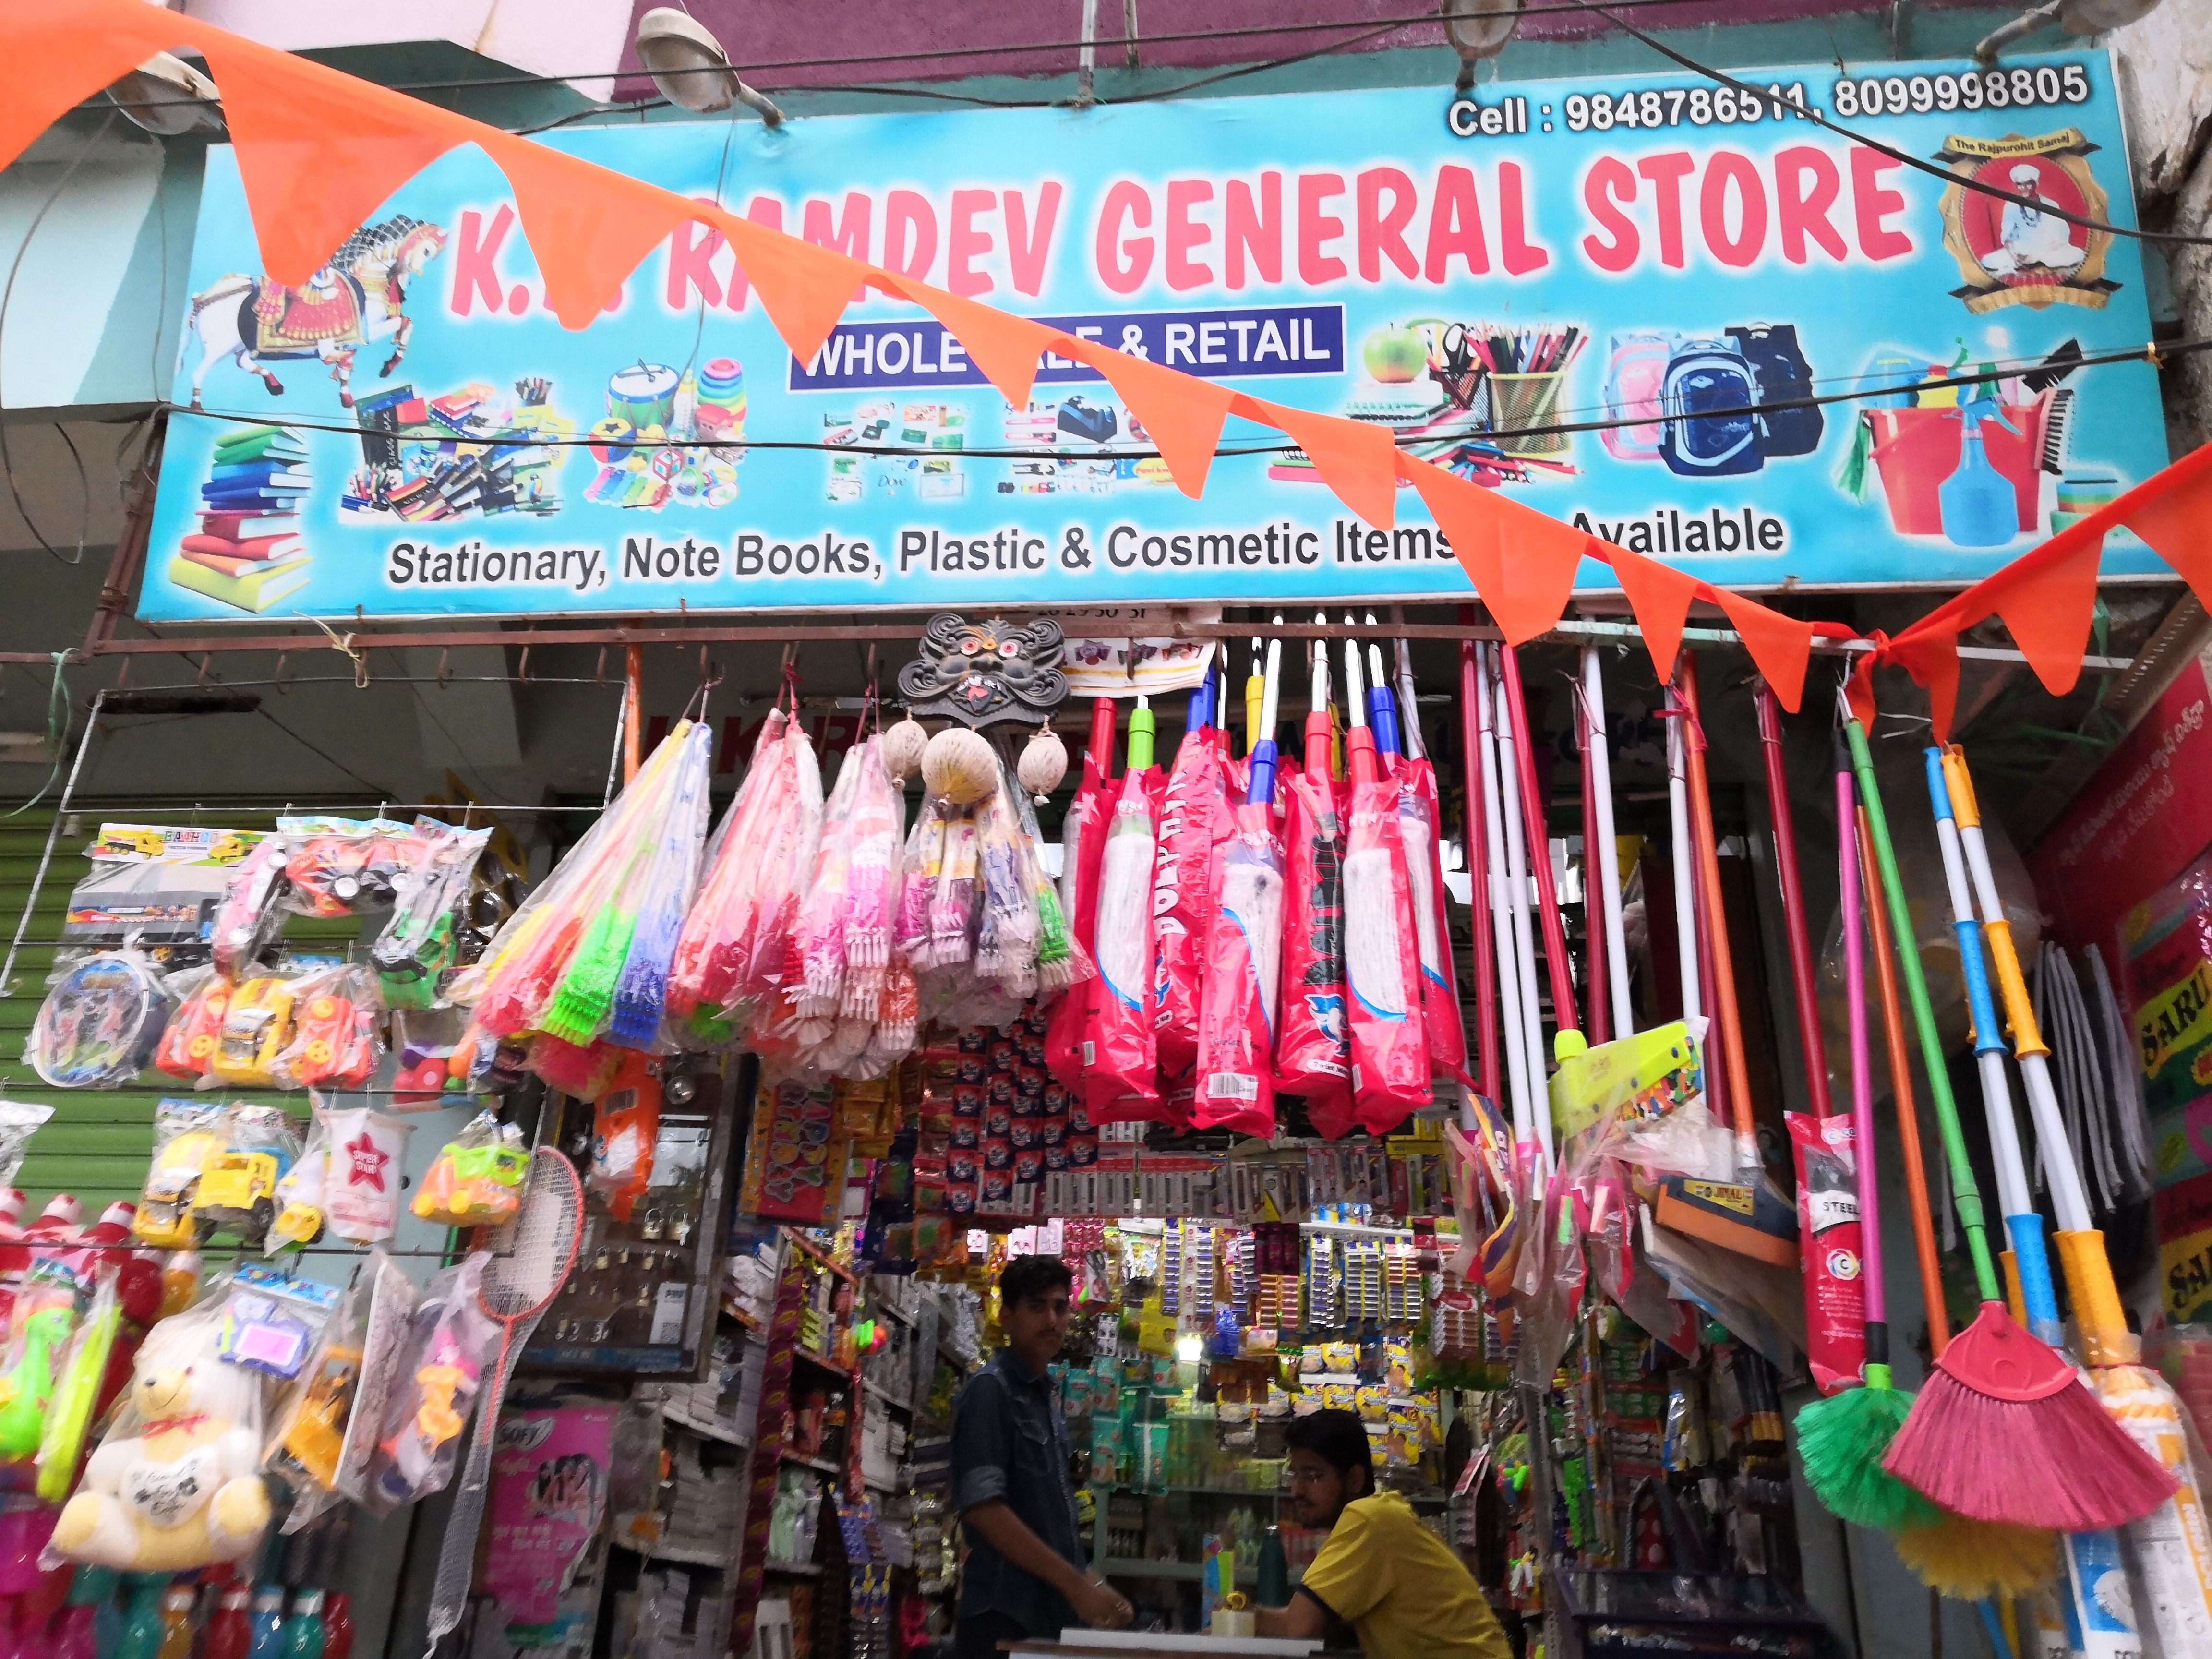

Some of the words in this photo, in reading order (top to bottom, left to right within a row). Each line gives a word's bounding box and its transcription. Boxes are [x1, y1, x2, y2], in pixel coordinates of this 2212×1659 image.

[1449, 97, 1527, 136] Cell
[1835, 66, 2088, 116] 8099998805
[1955, 139, 1975, 152] The
[1094, 161, 1548, 294] GENERAL
[1582, 145, 1914, 272] STORE
[1119, 324, 1151, 362] &
[1165, 318, 1331, 365] RETAIL
[388, 542, 606, 590] Stationary,
[623, 538, 719, 577] Note
[735, 532, 882, 580] Books,
[900, 528, 1046, 571] Plastic
[1060, 526, 1093, 568] &
[1107, 521, 1320, 567] Cosmetic
[1336, 520, 1455, 561] Items
